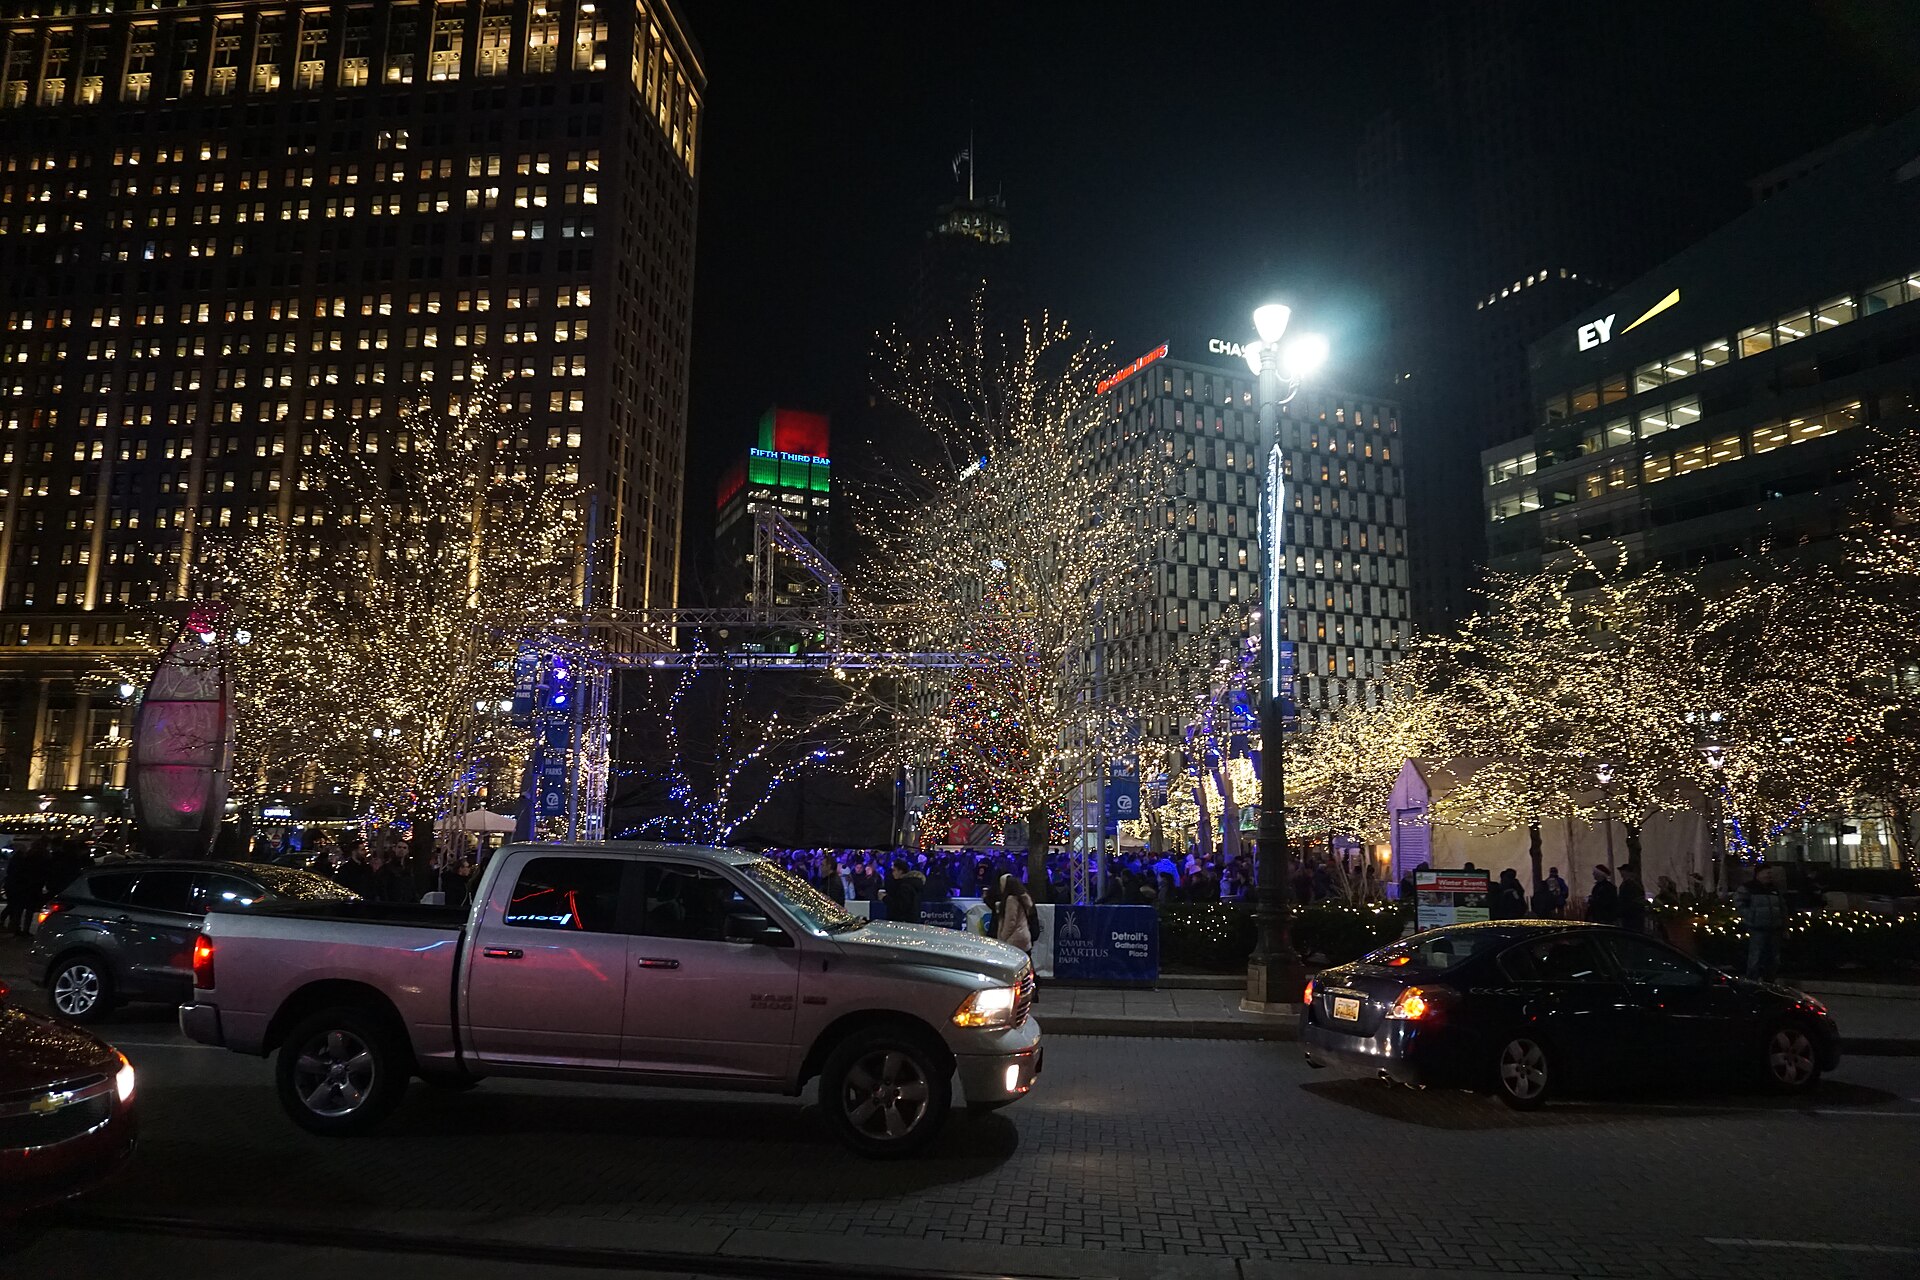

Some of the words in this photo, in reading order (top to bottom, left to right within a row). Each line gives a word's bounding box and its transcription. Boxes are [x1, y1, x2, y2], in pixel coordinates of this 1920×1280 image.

[1578, 313, 1616, 352] EY
[1209, 338, 1247, 358] CHA
[1097, 363, 1137, 395] Quicken
[1136, 344, 1168, 373] Loans
[750, 447, 778, 459] FIFTH
[780, 451, 811, 463] THIRD
[812, 455, 831, 466] BAN
[545, 767, 562, 776] PARKS
[1439, 879, 1462, 887] Winter
[1463, 879, 1487, 887] Events
[920, 910, 954, 919] Detroit's
[1111, 931, 1149, 941] Detroit's
[1060, 940, 1094, 948] CAMPUS
[1114, 941, 1149, 951] Gathering
[1059, 948, 1109, 958] MARTIUS
[1128, 950, 1149, 958] Place
